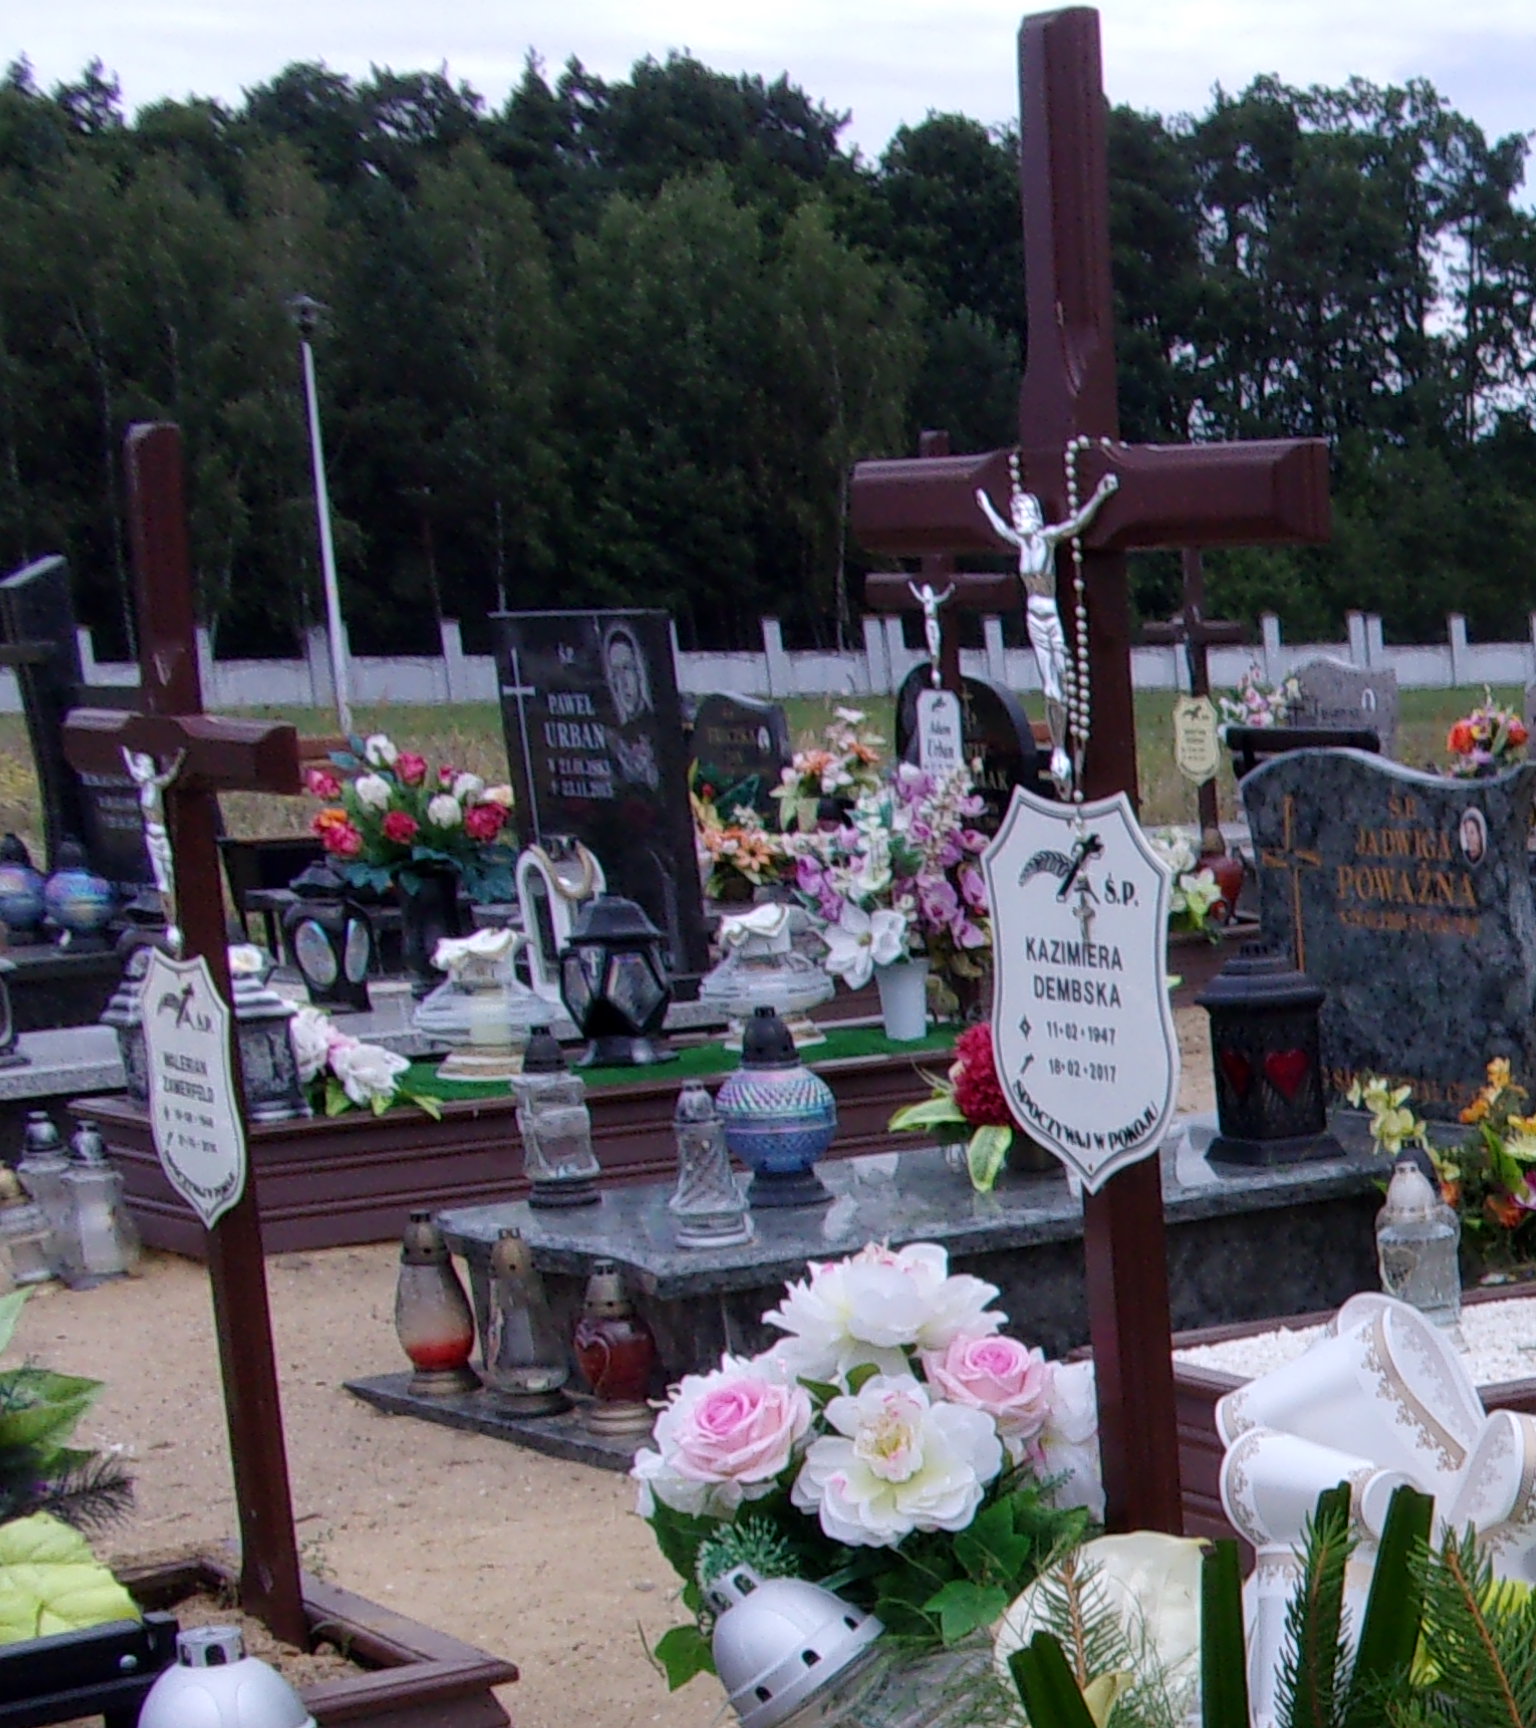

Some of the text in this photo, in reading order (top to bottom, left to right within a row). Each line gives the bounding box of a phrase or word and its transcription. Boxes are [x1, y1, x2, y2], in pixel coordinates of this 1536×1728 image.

[544, 721, 607, 749] URBAN
[1355, 826, 1452, 860] JADWIGA
[1025, 936, 1123, 971] KAZIMIERA
[1033, 974, 1122, 1009] DEMBSKA
[1012, 1078, 1091, 1150] SPOCZYWAJ
[1108, 1101, 1158, 1150] POKOJU
